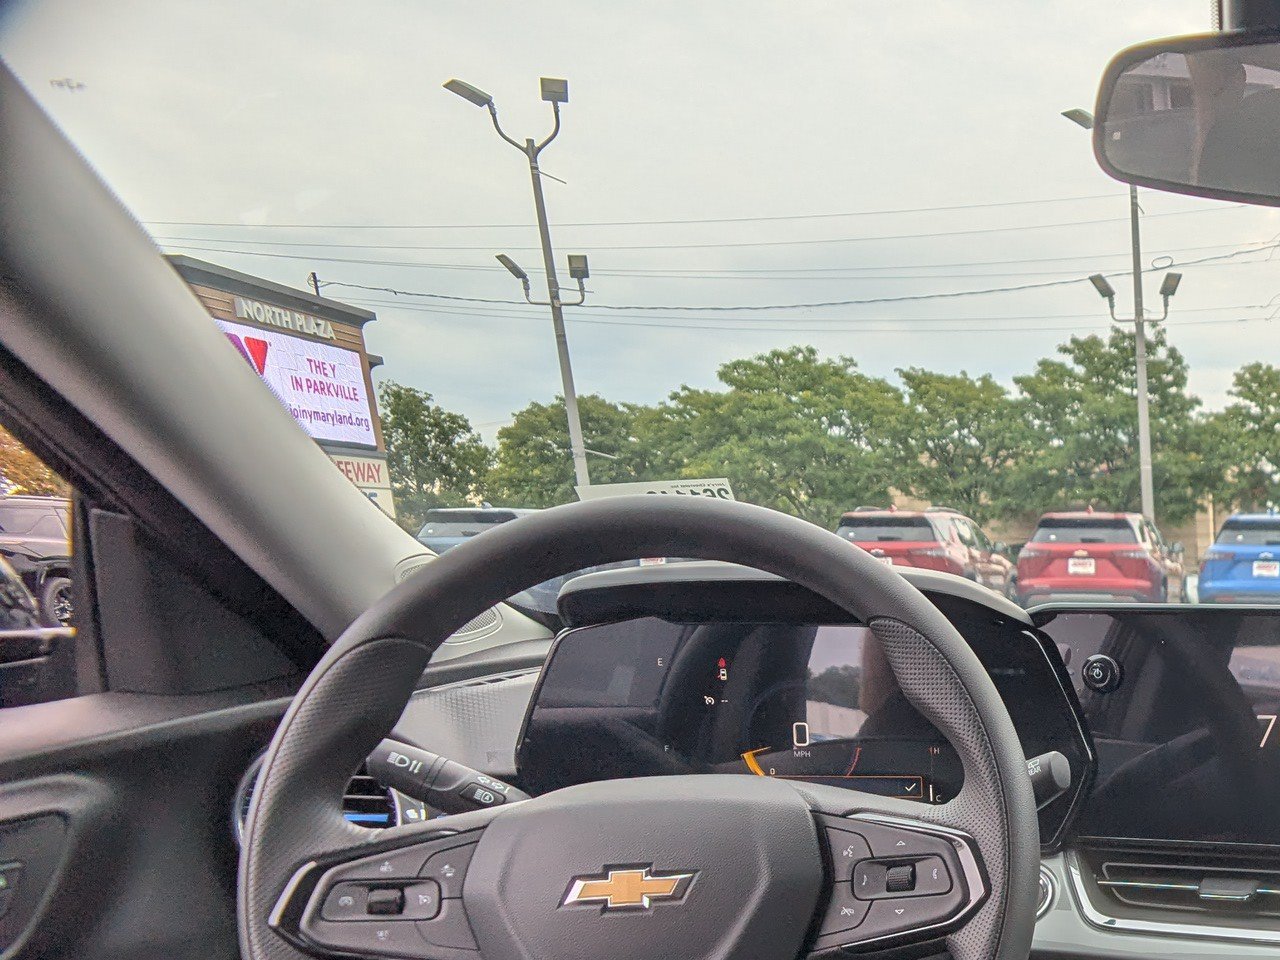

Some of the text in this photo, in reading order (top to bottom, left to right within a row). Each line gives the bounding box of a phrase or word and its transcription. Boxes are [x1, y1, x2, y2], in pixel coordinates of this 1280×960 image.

[236, 297, 337, 340] NORTH PLAZA
[306, 357, 336, 378] THE Y
[290, 375, 359, 402] IN PARKVILLE
[657, 657, 663, 667] E
[793, 722, 809, 746] 0
[793, 750, 811, 758] MPH
